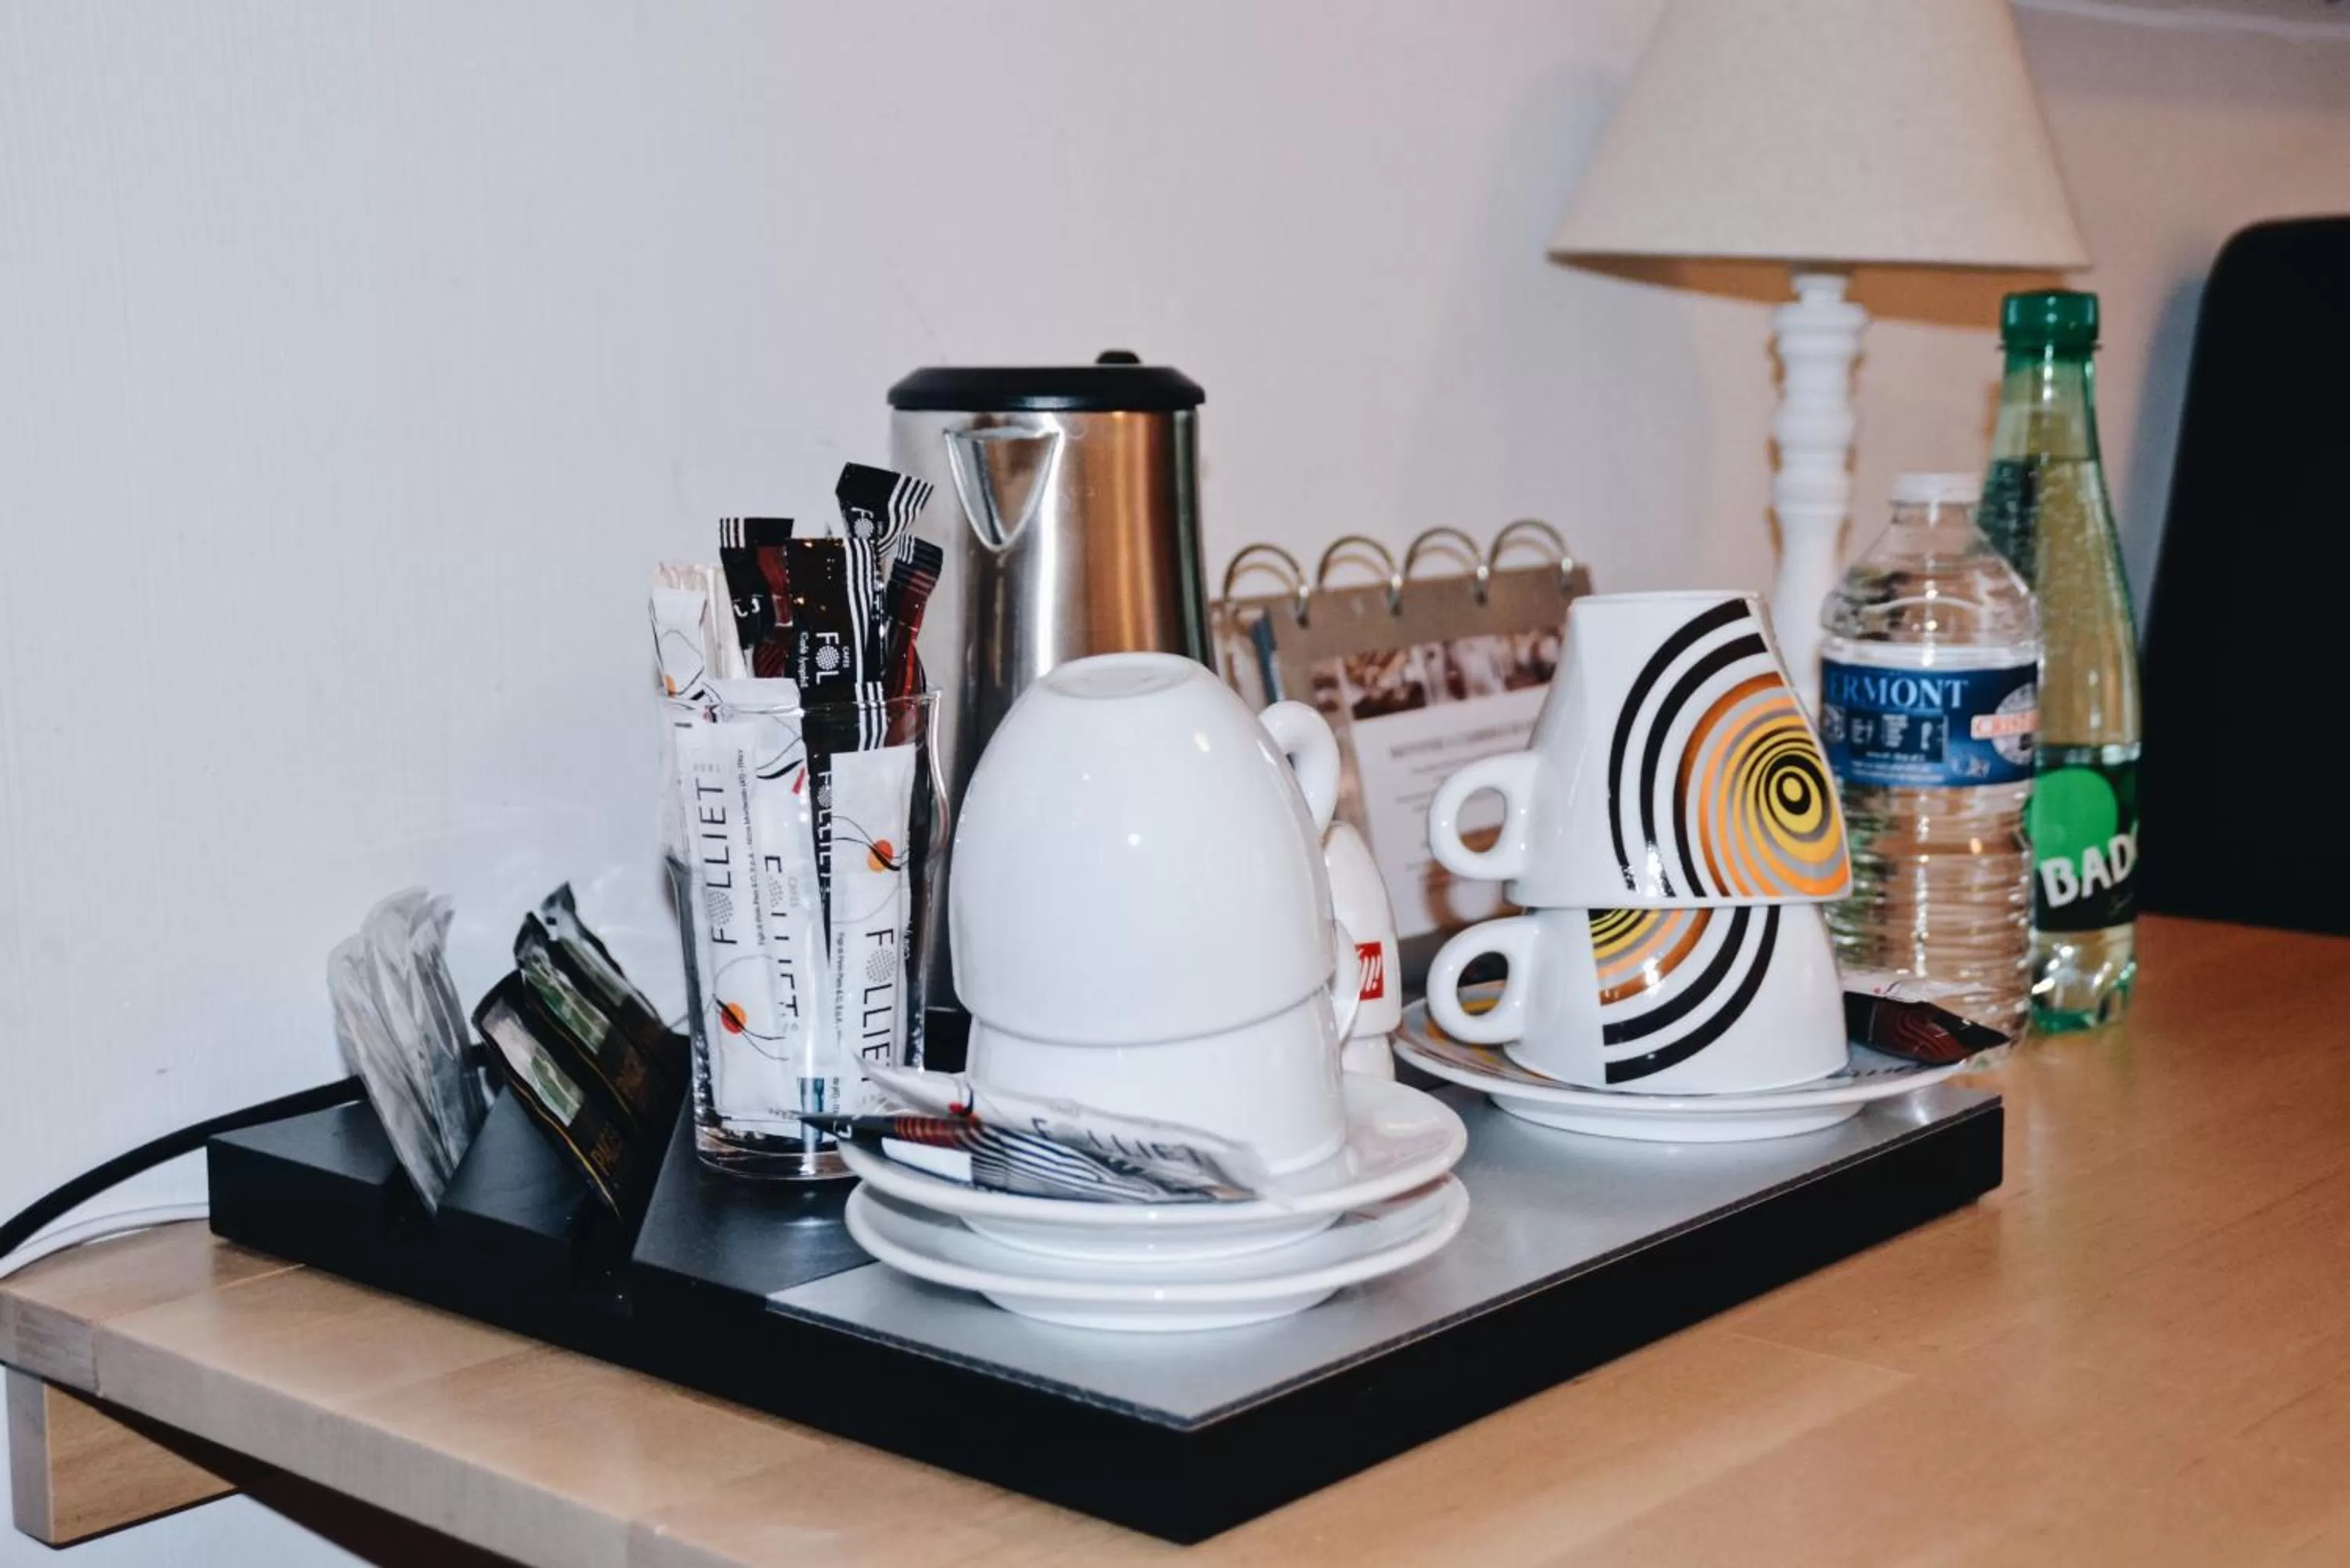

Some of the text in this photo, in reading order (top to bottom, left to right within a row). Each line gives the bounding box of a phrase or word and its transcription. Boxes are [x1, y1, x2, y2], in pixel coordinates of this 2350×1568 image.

[816, 631, 839, 685] FOL
[696, 778, 737, 945] FOLLIET
[2039, 822, 2138, 909] BAD
[862, 928, 895, 1082] FOLLIE
